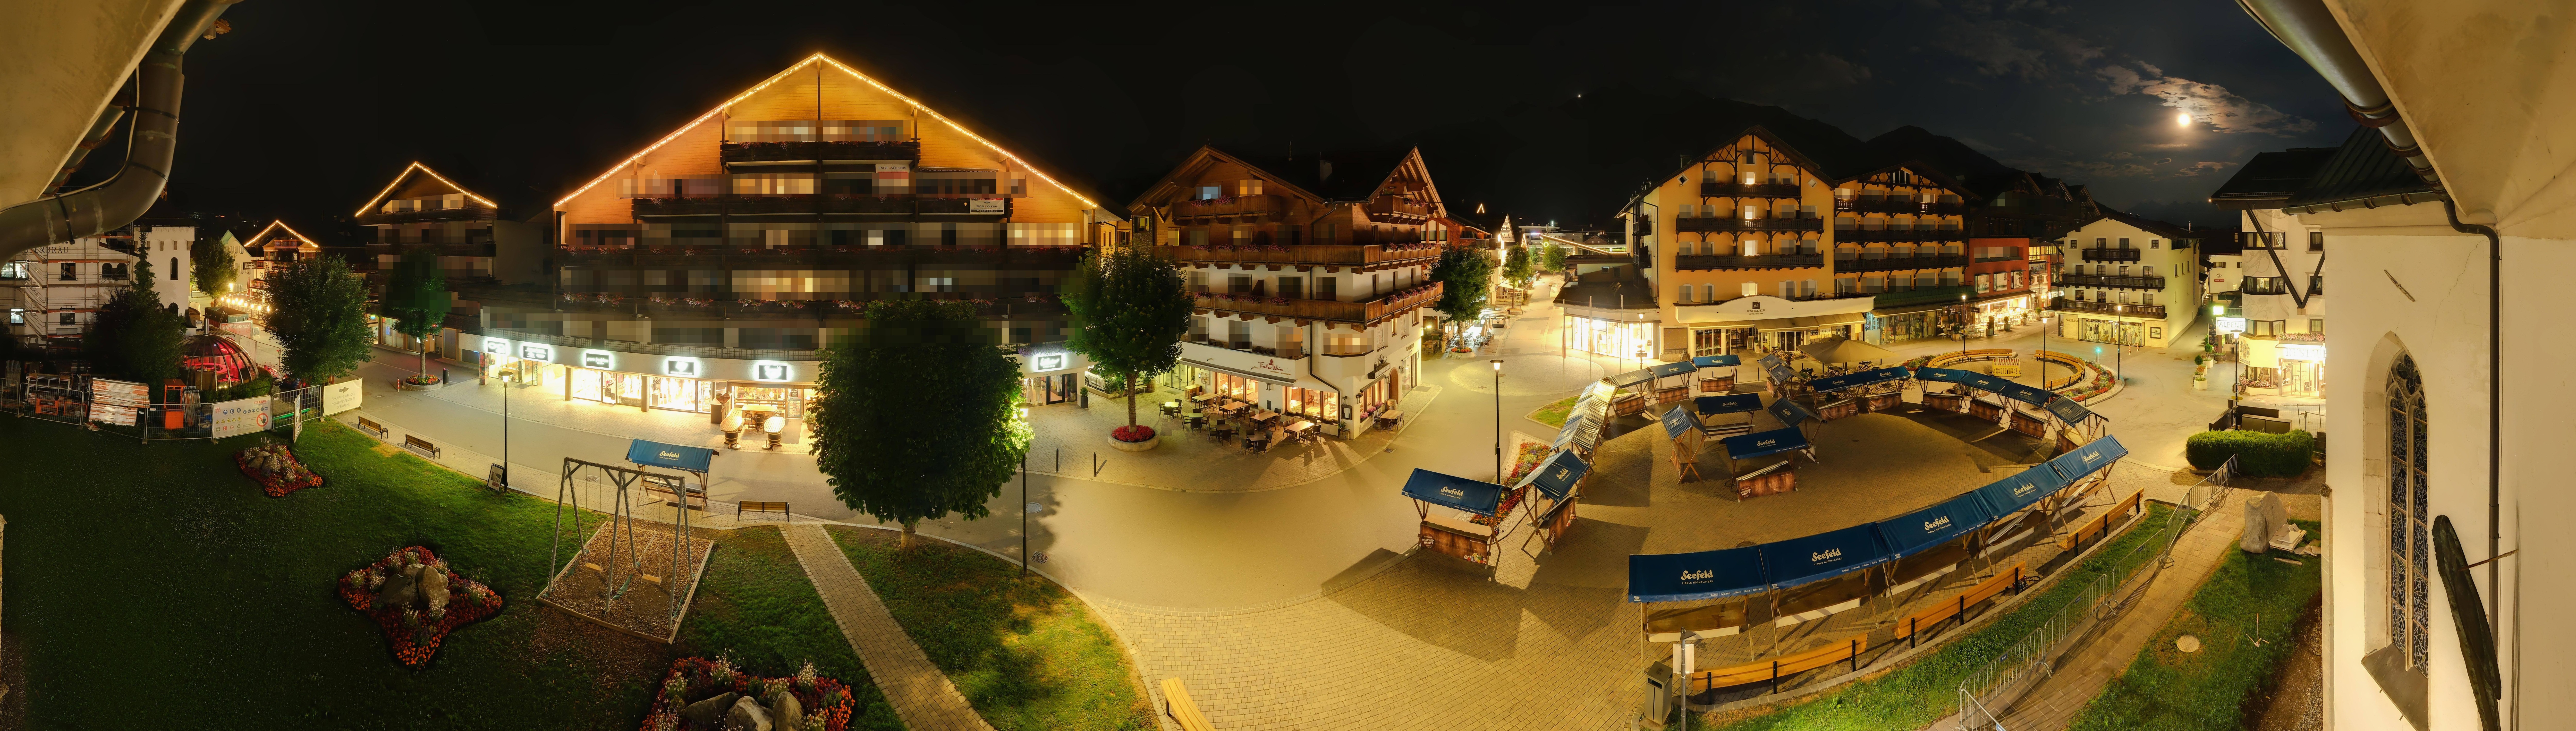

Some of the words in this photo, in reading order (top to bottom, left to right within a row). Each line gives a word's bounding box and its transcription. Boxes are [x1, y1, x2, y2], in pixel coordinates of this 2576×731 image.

[332, 397, 355, 405] KONGRESSZENTRUM
[2083, 451, 2099, 462] Seefeld
[1556, 468, 1568, 479] Seefeld
[1440, 486, 1464, 496] Seefeld
[2014, 483, 2034, 495] Seefeld
[1925, 515, 1949, 530] Seefeld
[1811, 548, 1841, 562] Seefeld
[1681, 569, 1713, 580] Seefeld
